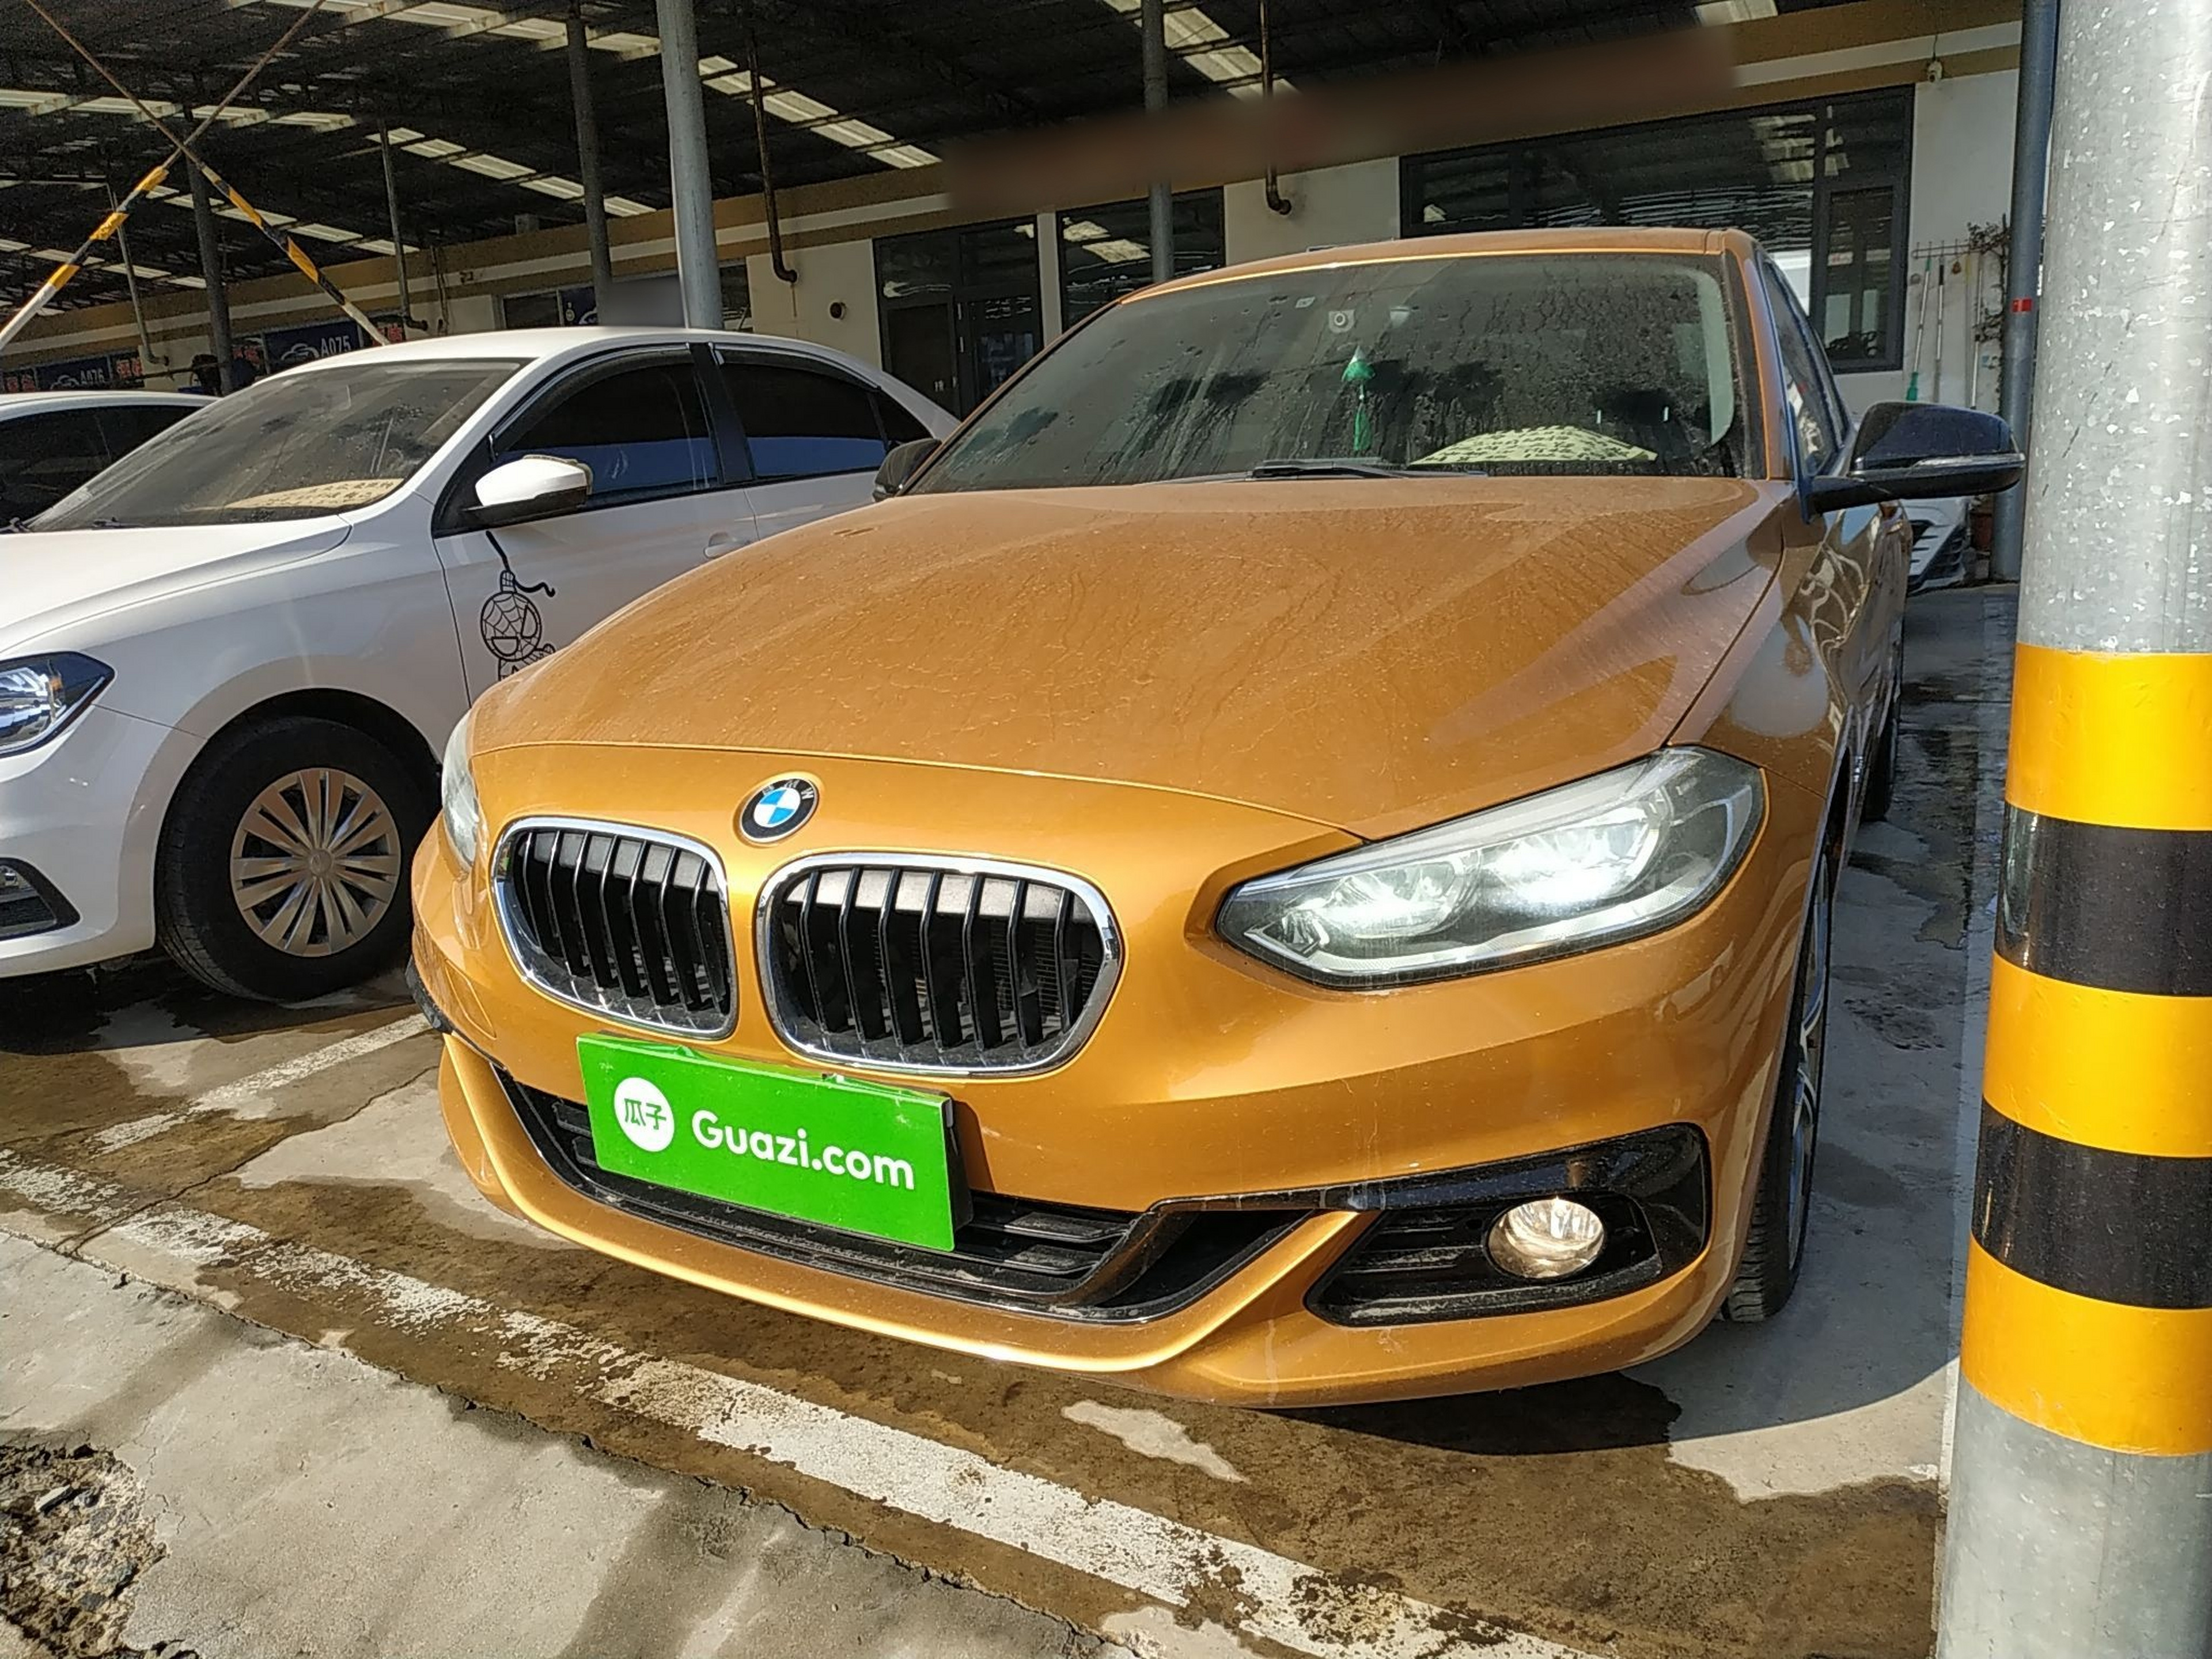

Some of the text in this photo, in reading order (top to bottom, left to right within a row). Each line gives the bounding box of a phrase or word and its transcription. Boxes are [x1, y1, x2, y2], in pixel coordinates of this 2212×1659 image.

[321, 336, 351, 357] A075
[762, 779, 815, 800] BMW
[624, 1097, 666, 1130] 瓜子
[692, 1109, 915, 1191] Guazi.com
